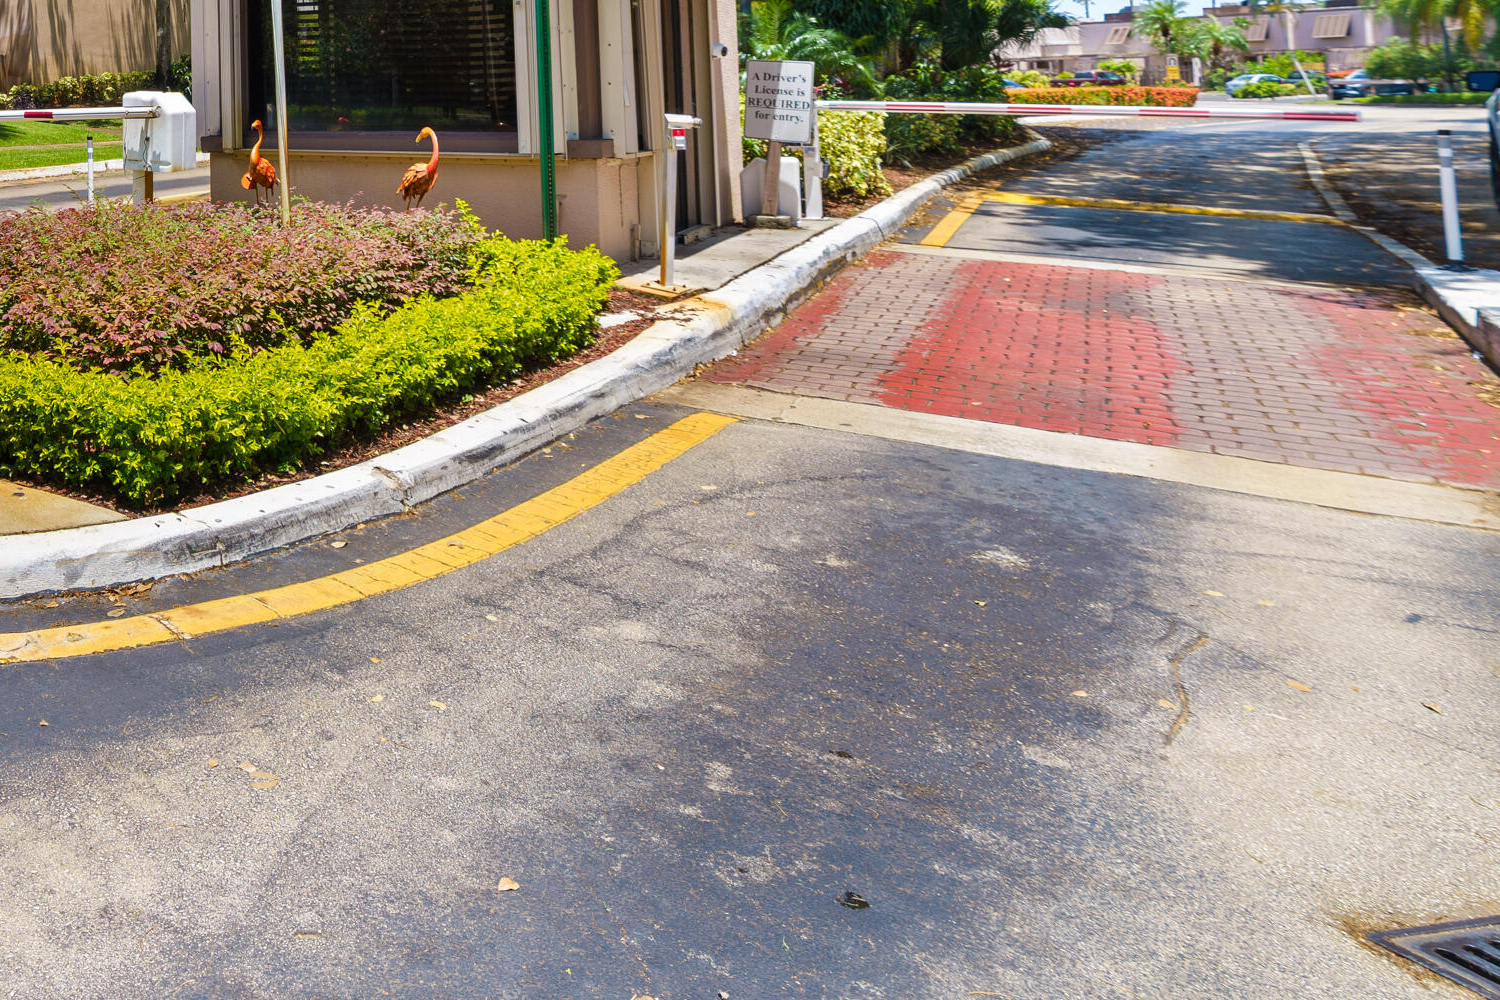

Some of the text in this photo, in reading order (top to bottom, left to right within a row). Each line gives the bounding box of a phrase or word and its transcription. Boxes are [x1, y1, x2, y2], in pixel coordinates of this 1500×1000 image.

[752, 72, 806, 83] A Driver's
[755, 85, 804, 96] License is
[748, 98, 810, 110] REQUIRED
[756, 111, 804, 124] for entry.
